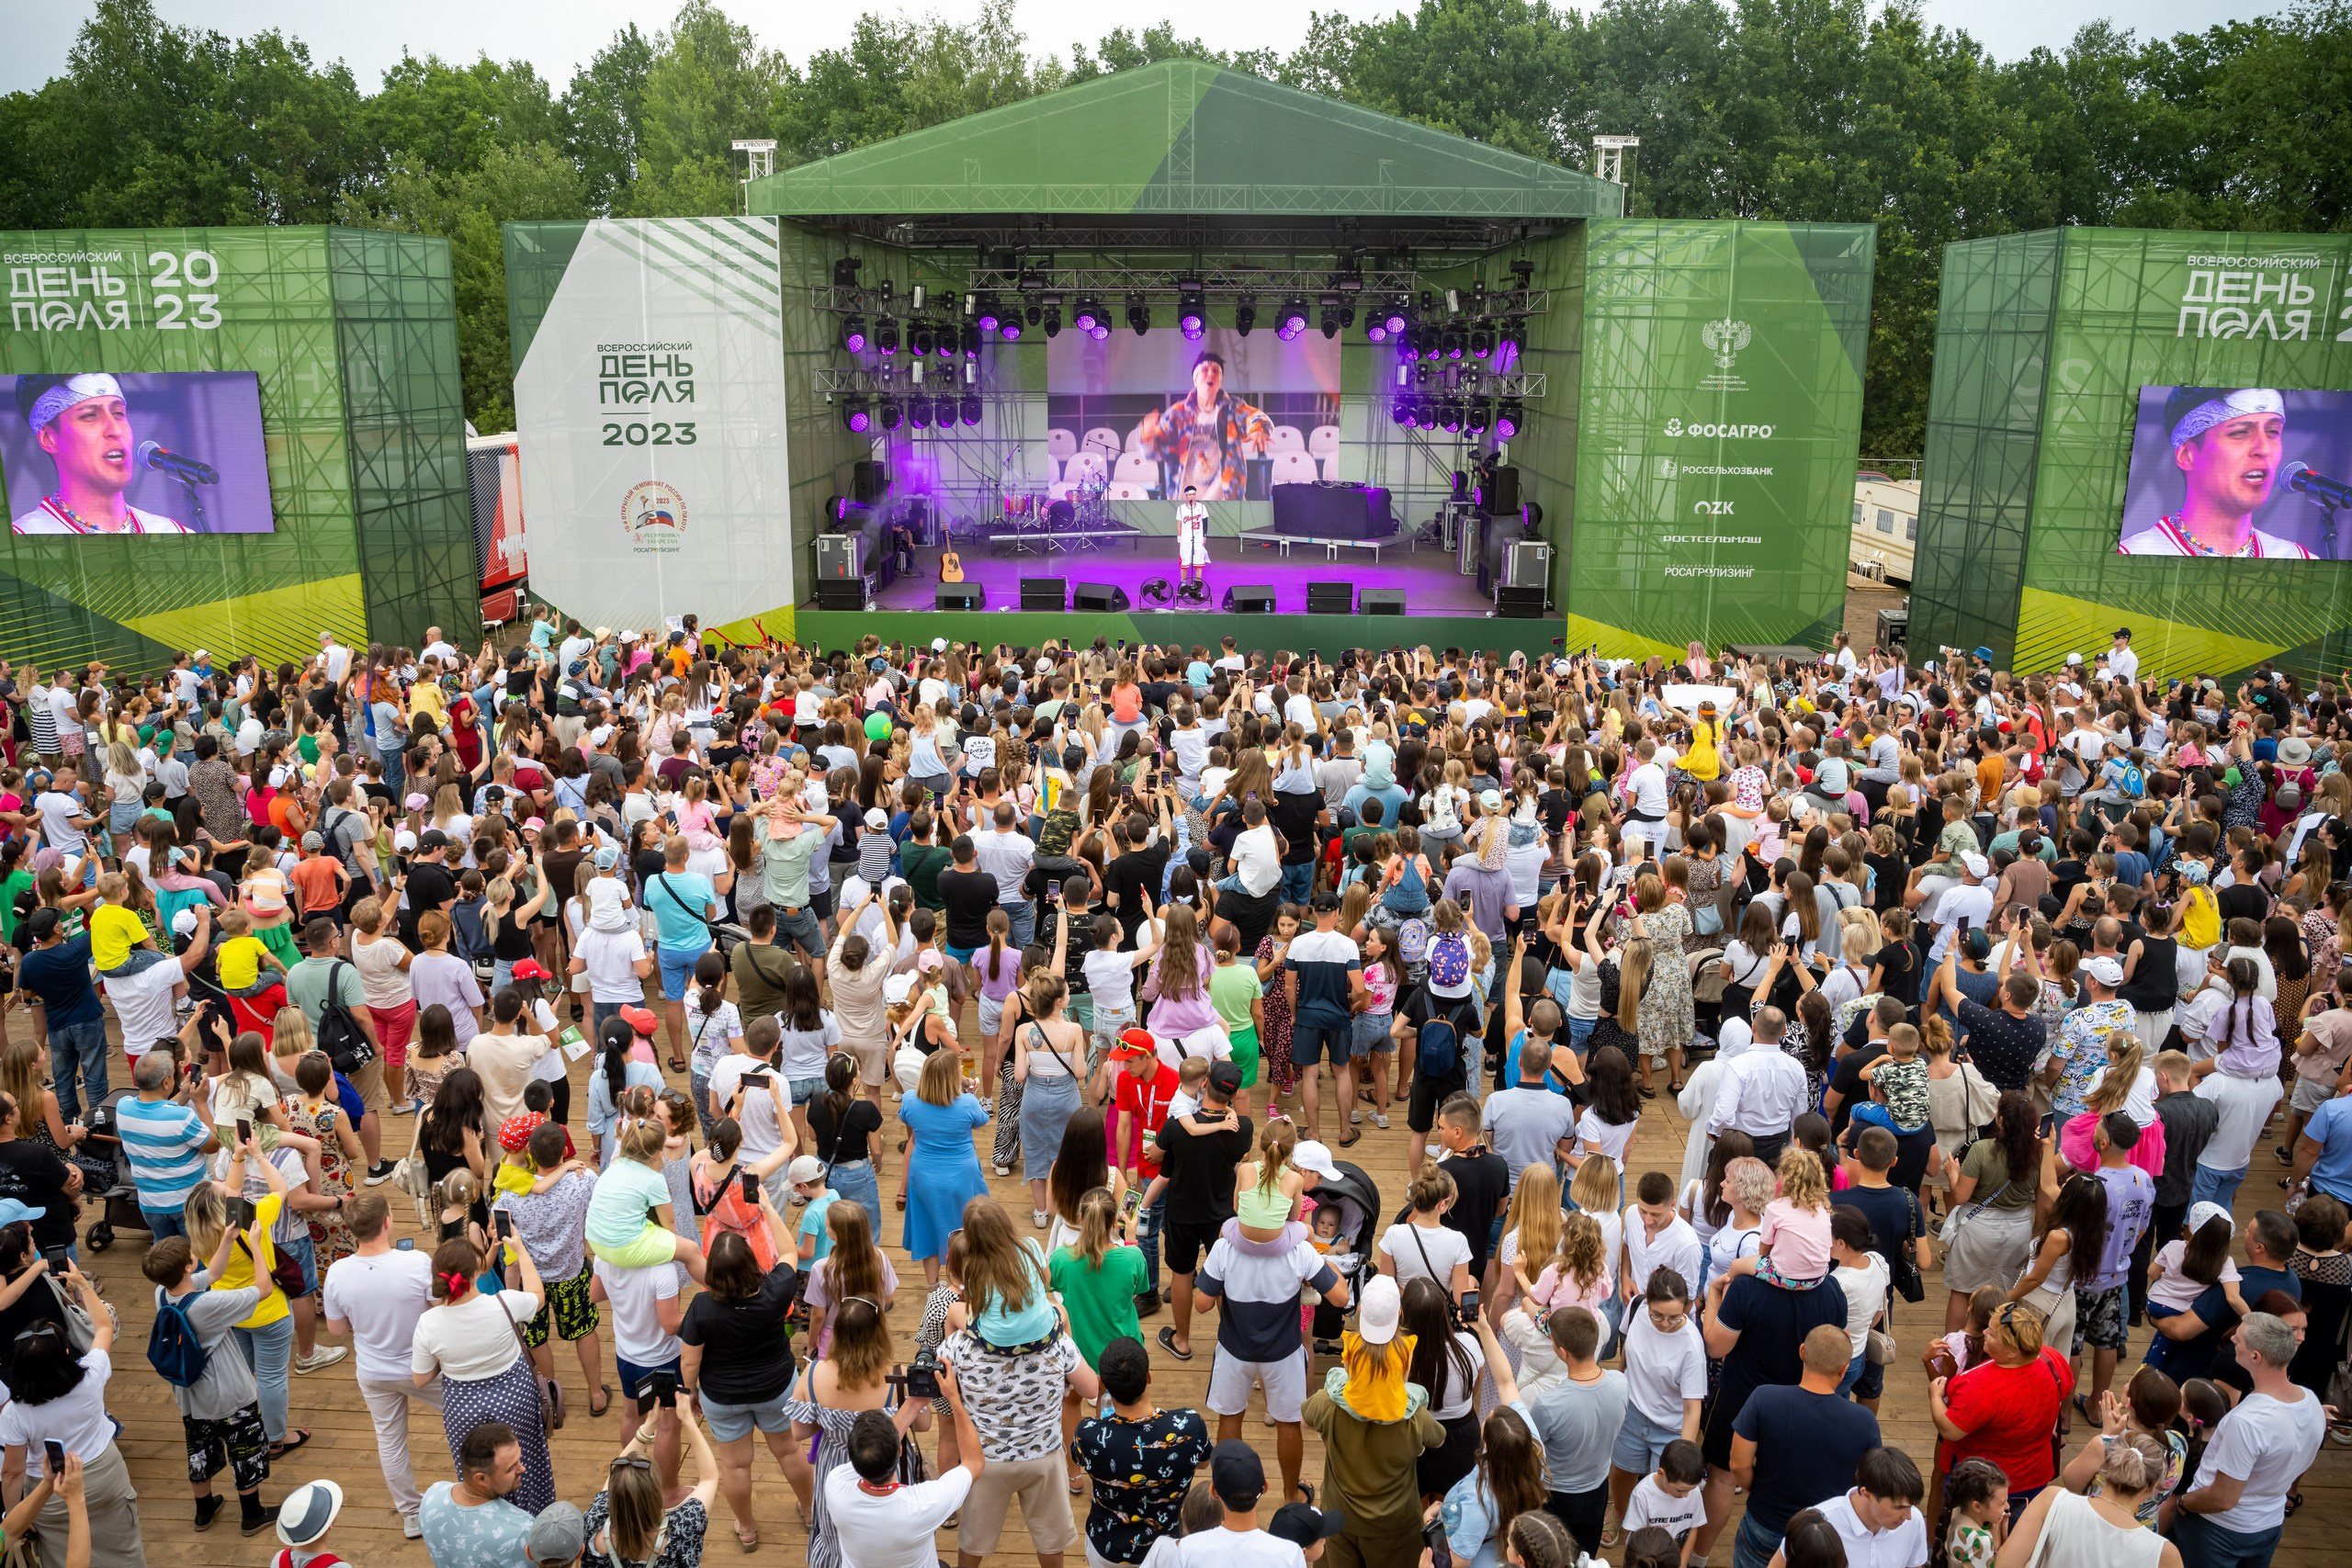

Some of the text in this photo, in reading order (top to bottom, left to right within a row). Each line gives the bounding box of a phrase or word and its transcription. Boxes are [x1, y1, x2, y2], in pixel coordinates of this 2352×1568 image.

[4, 250, 122, 265] ВСЕРОССИЙСКИЙ
[148, 251, 219, 288] 20
[2187, 254, 2321, 270] ВСЕРОССИЙСКИЙ
[10, 265, 126, 298] ДЕНЬ
[2182, 270, 2315, 306] ДЕНЬ
[11, 300, 131, 332] ПОЛЯ
[153, 293, 222, 330] 23
[2177, 306, 2312, 341] ПОЛЯ
[597, 341, 693, 353] ВСЕРОССИЙСКИЙ
[599, 354, 694, 378] ДЕНЬ
[600, 380, 695, 404] ПОЛЯ
[602, 422, 697, 446] 2023
[1688, 423, 1773, 438] ФОСАГРО
[1682, 466, 1773, 476] РОССЕЛЬХОЗБАНК
[1663, 536, 1762, 544] РОСТСЕЛЬМАШ
